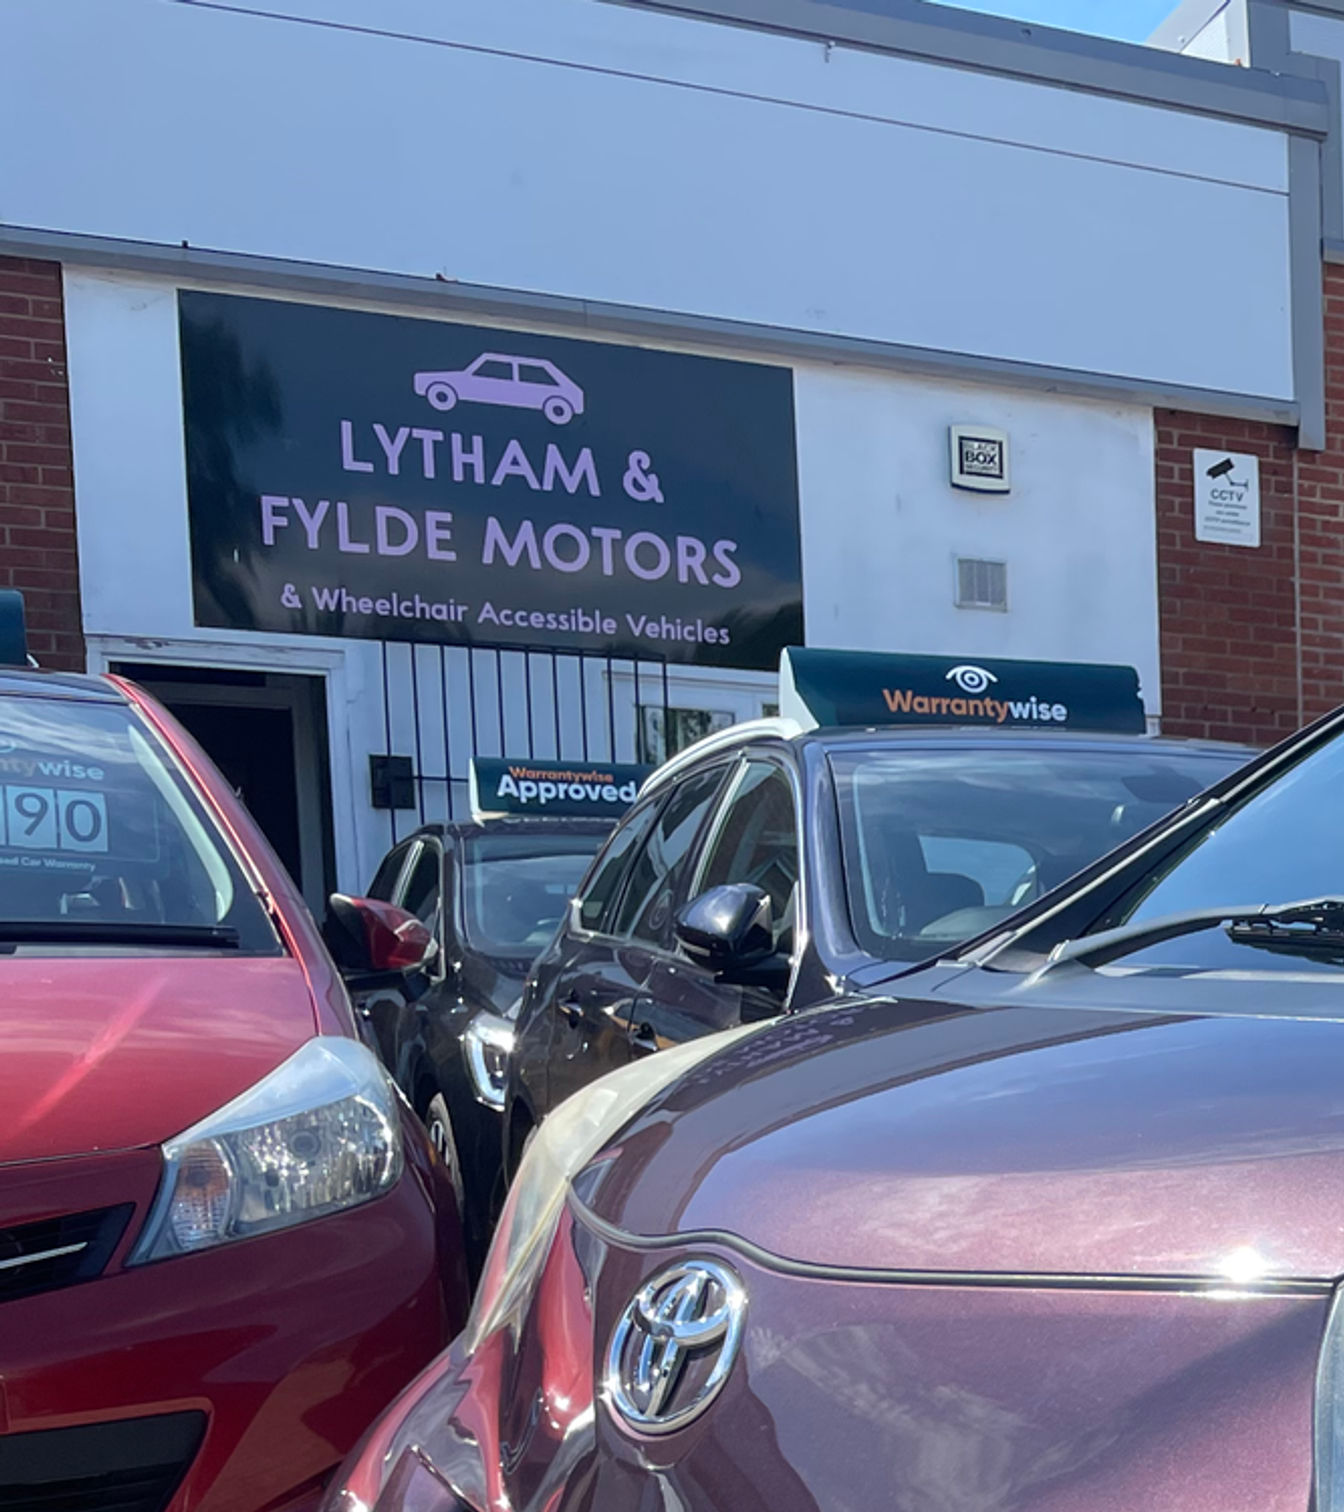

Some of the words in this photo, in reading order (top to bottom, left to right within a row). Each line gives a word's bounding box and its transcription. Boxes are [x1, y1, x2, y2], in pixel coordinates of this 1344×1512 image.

[340, 420, 601, 497] LYTHAM
[623, 450, 665, 503] &
[965, 450, 997, 465] BOX
[1210, 488, 1244, 502] CCTV
[260, 495, 457, 562] FYLDE
[482, 516, 742, 588] MOTORS
[280, 583, 303, 609] &
[311, 586, 468, 623] Wheelchair
[477, 601, 617, 635] Accessible
[626, 614, 730, 645] Vehicles
[882, 688, 1068, 723] Warrantywise
[497, 774, 637, 804] Approved
[508, 766, 614, 783] Warrantywise
